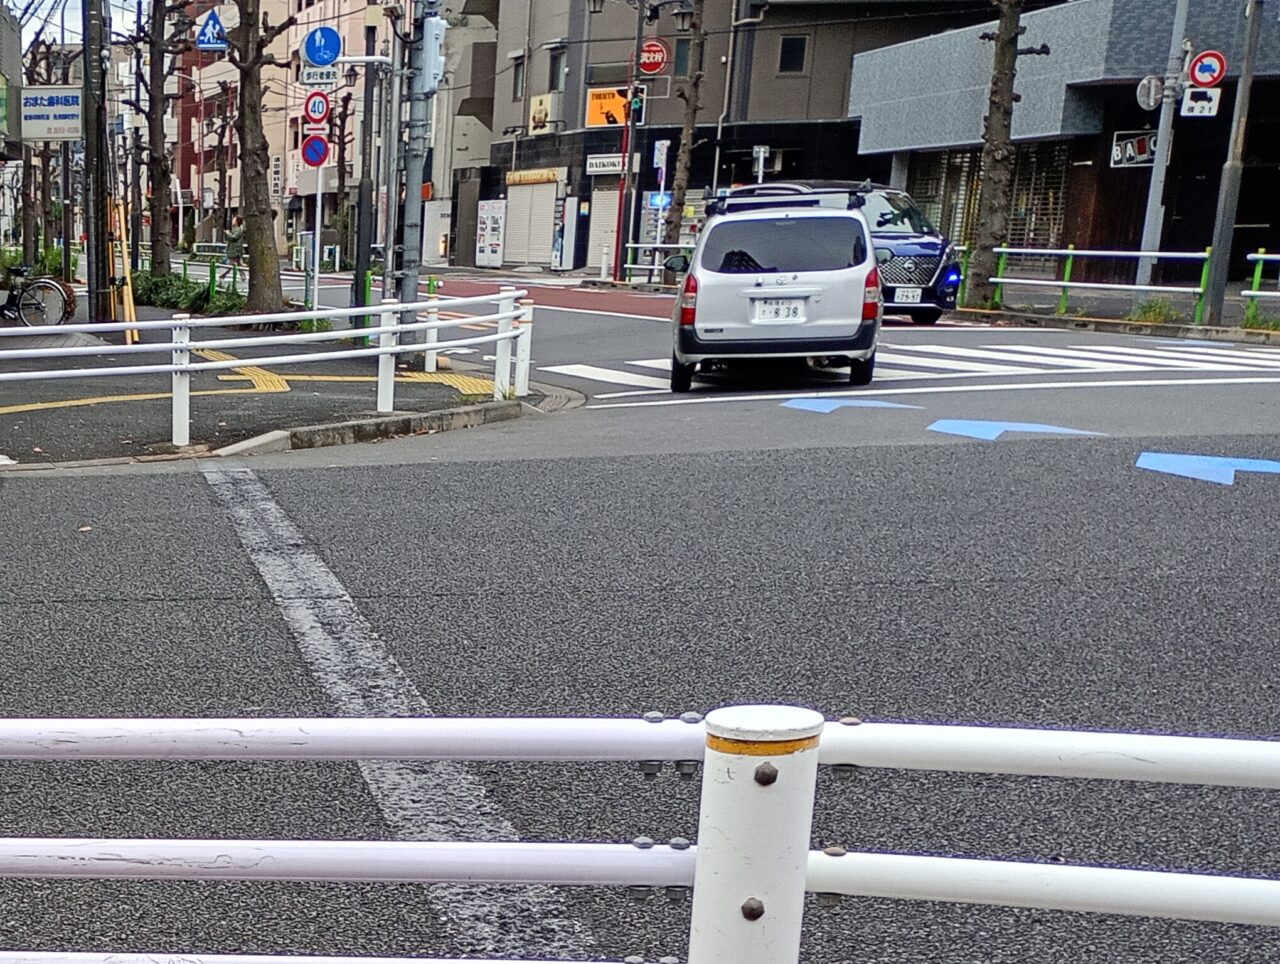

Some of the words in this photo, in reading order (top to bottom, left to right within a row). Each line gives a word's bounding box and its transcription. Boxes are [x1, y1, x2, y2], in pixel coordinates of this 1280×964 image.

[306, 70, 338, 81] 歩行者優先
[23, 96, 80, 107] おまた歯科医院
[311, 100, 324, 115] 40
[588, 160, 621, 170] DAIKOK
